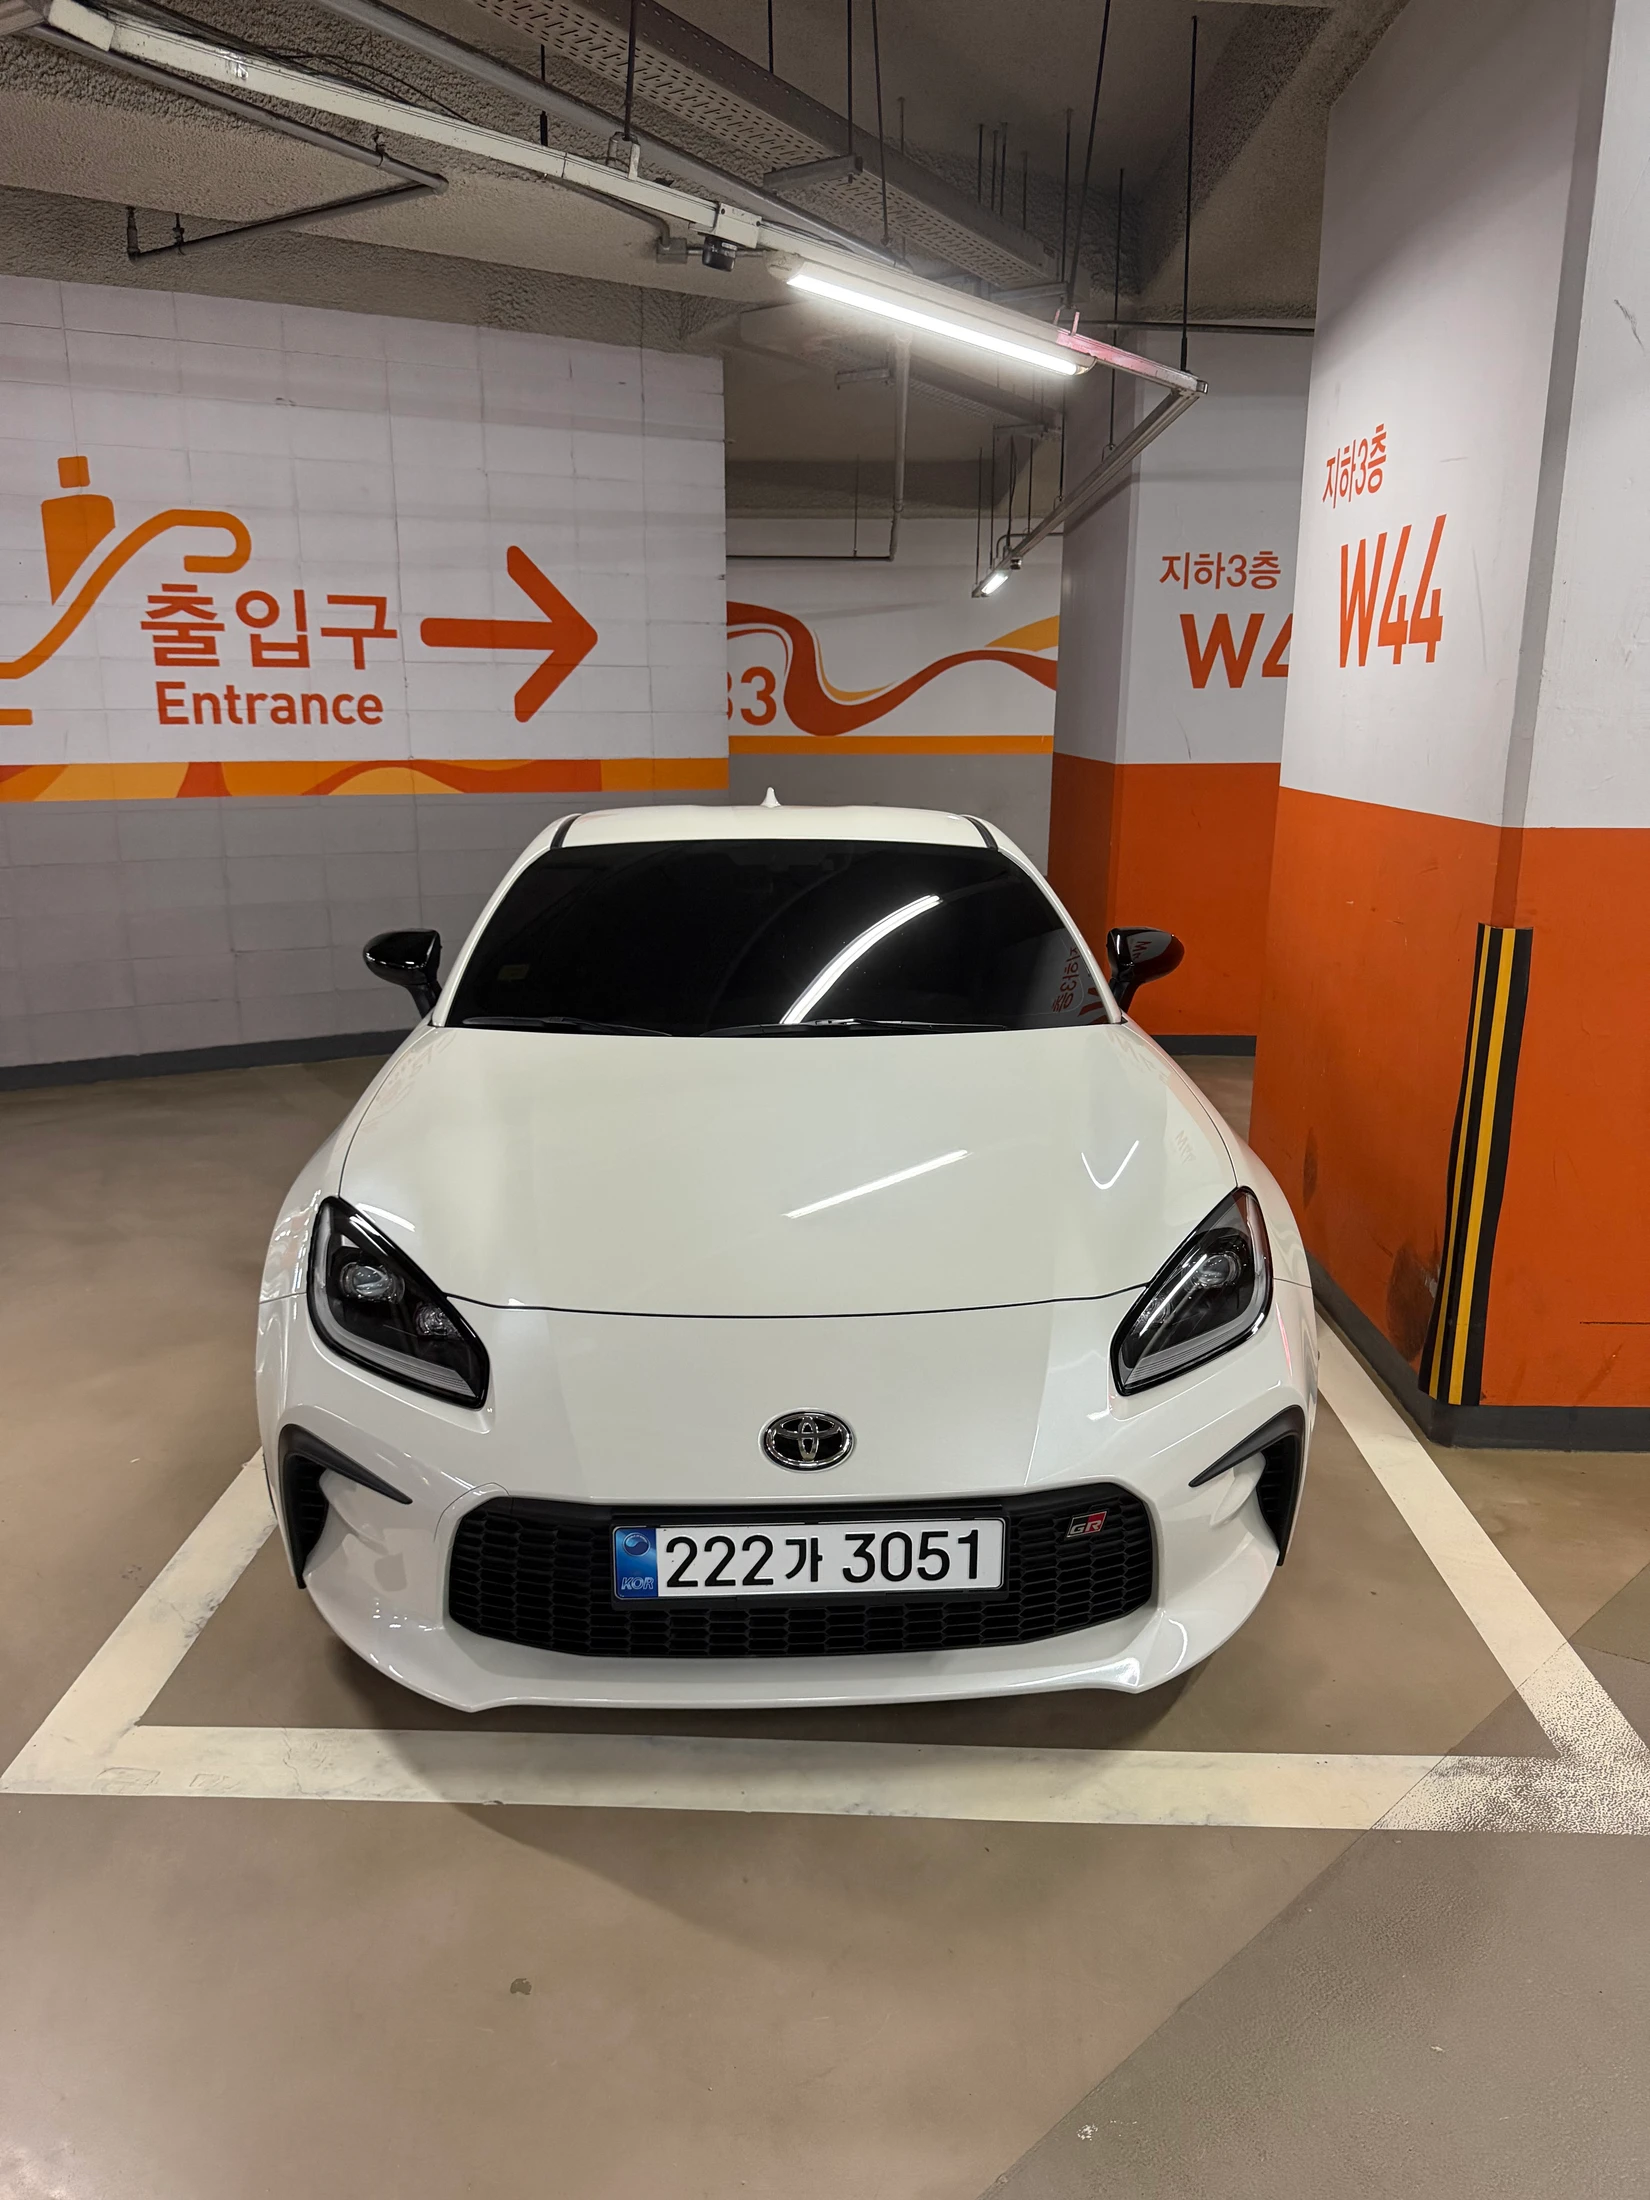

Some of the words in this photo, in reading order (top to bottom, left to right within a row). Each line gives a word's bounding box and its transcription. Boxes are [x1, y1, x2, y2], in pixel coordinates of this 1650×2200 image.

[1322, 423, 1387, 509] 지하3층
[1159, 550, 1281, 590] 지하3층
[1339, 514, 1446, 668] W44
[140, 583, 398, 670] 출입구
[155, 681, 384, 725] Entrance
[727, 666, 777, 726] 3
[1070, 1519, 1102, 1535] GR
[621, 1577, 655, 1591] KOR
[665, 1534, 824, 1588] 222가
[842, 1529, 979, 1584] 3051
